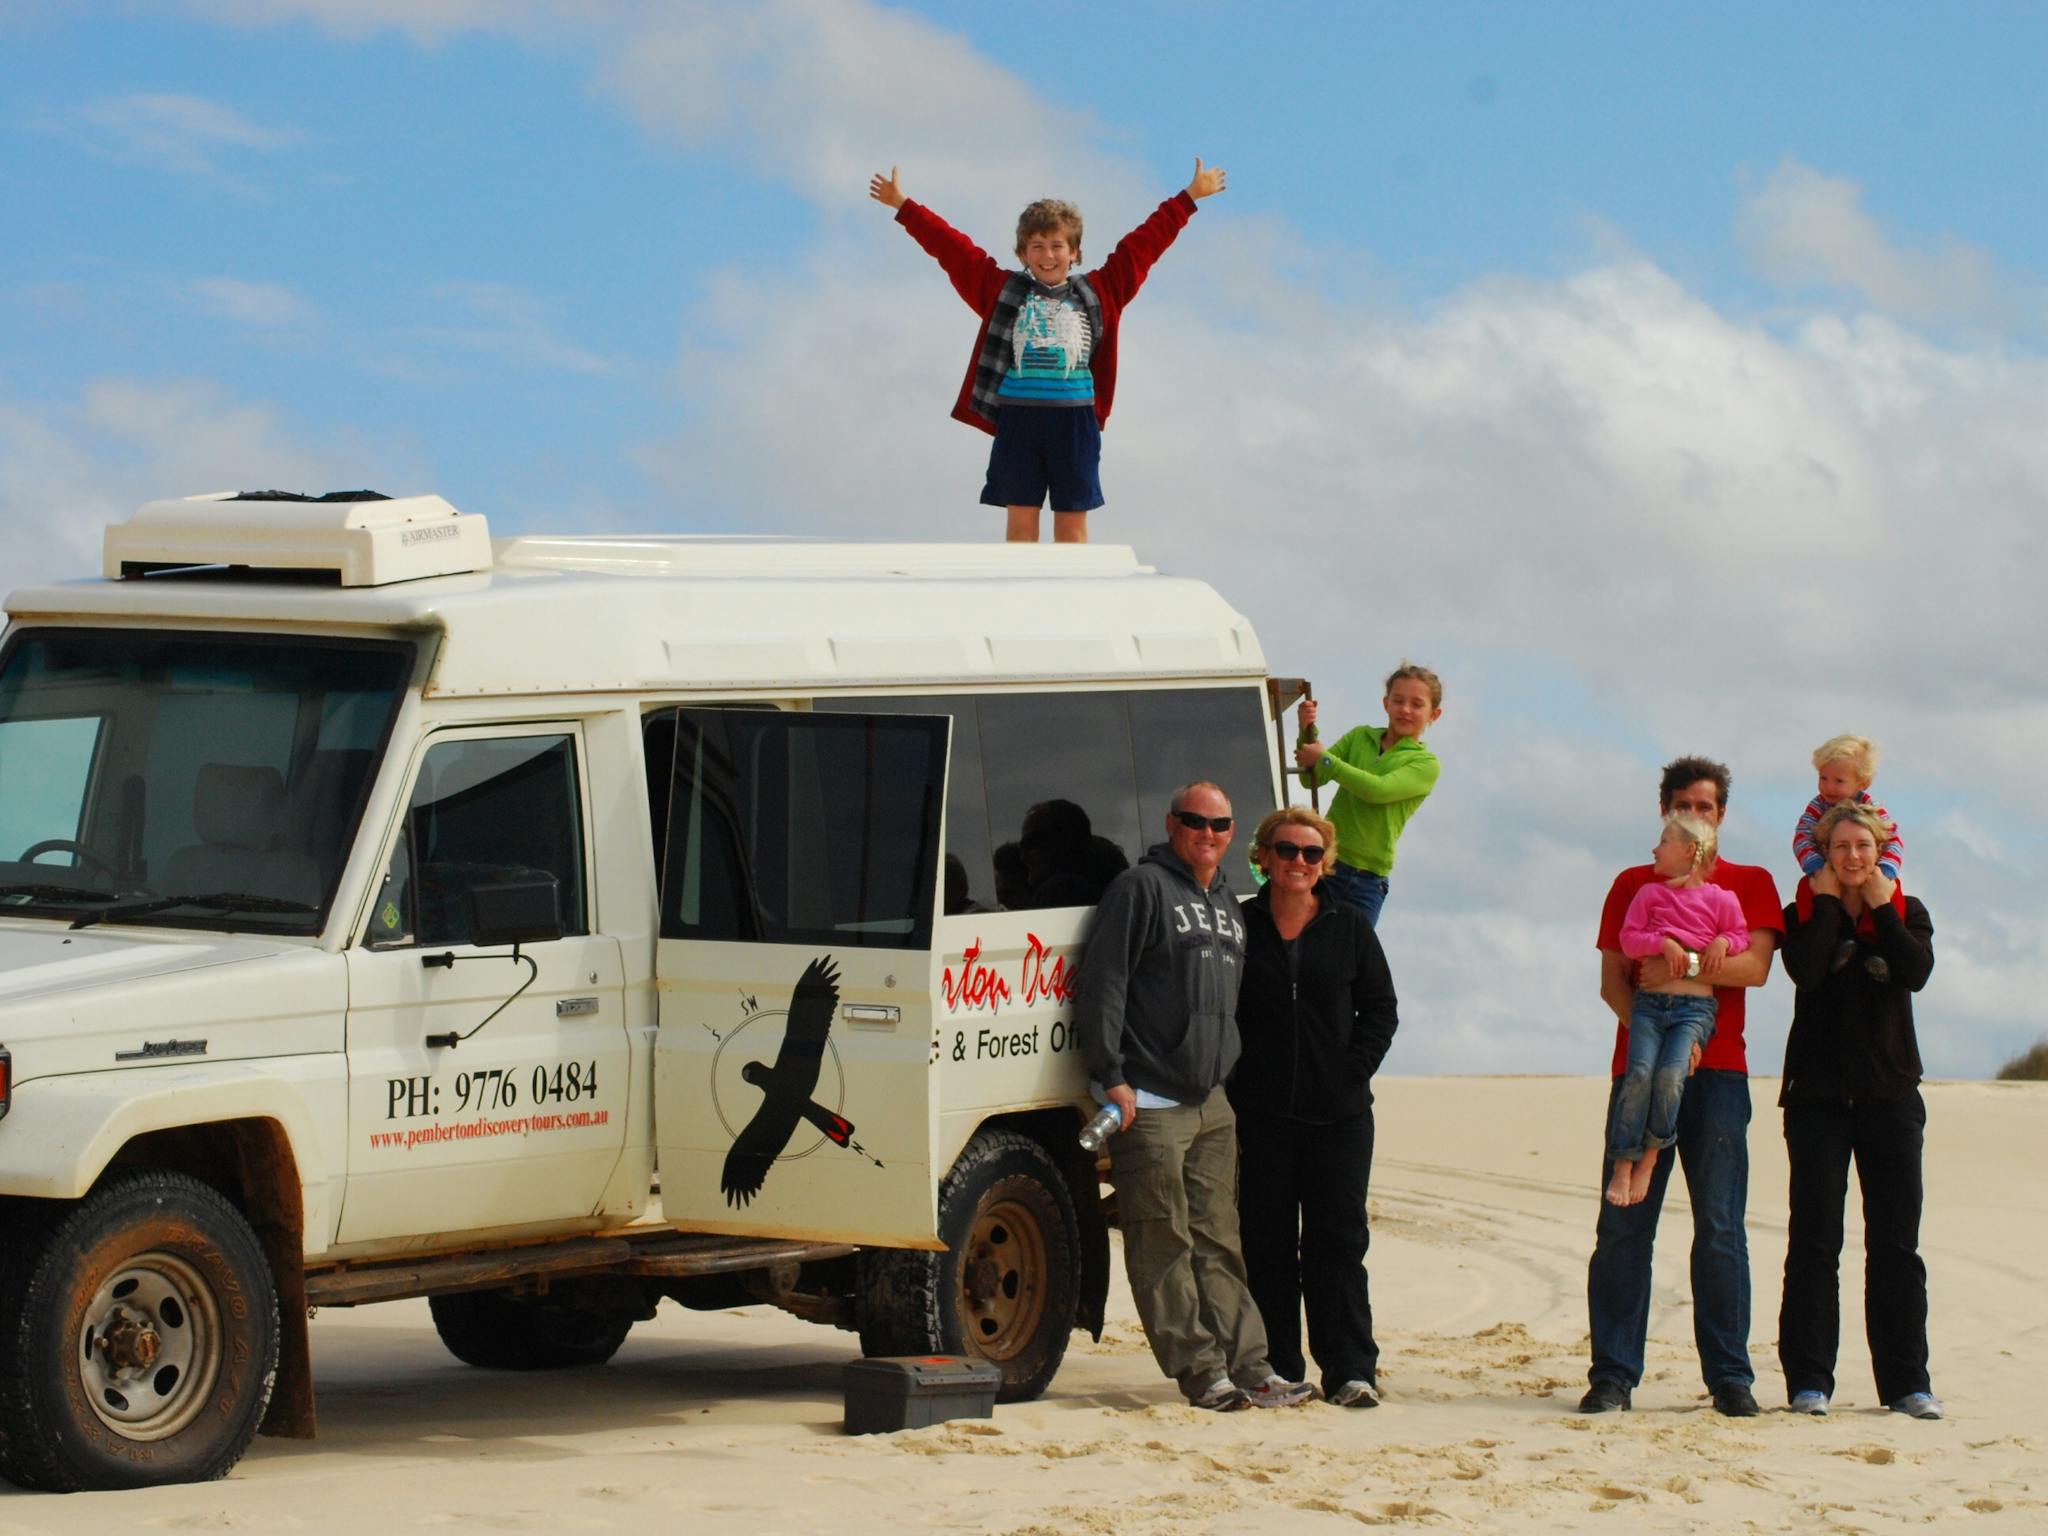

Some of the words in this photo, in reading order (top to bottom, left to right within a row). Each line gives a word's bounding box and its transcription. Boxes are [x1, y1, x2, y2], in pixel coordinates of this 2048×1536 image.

[1174, 902, 1244, 944] JEEP
[952, 1030, 966, 1062] &
[977, 1024, 1039, 1060] Forest
[386, 1076, 439, 1120] PH:
[455, 1067, 517, 1113] 9776
[532, 1060, 598, 1105] 0484
[370, 1109, 609, 1150] www.pembertondiscoverytours.com.au
